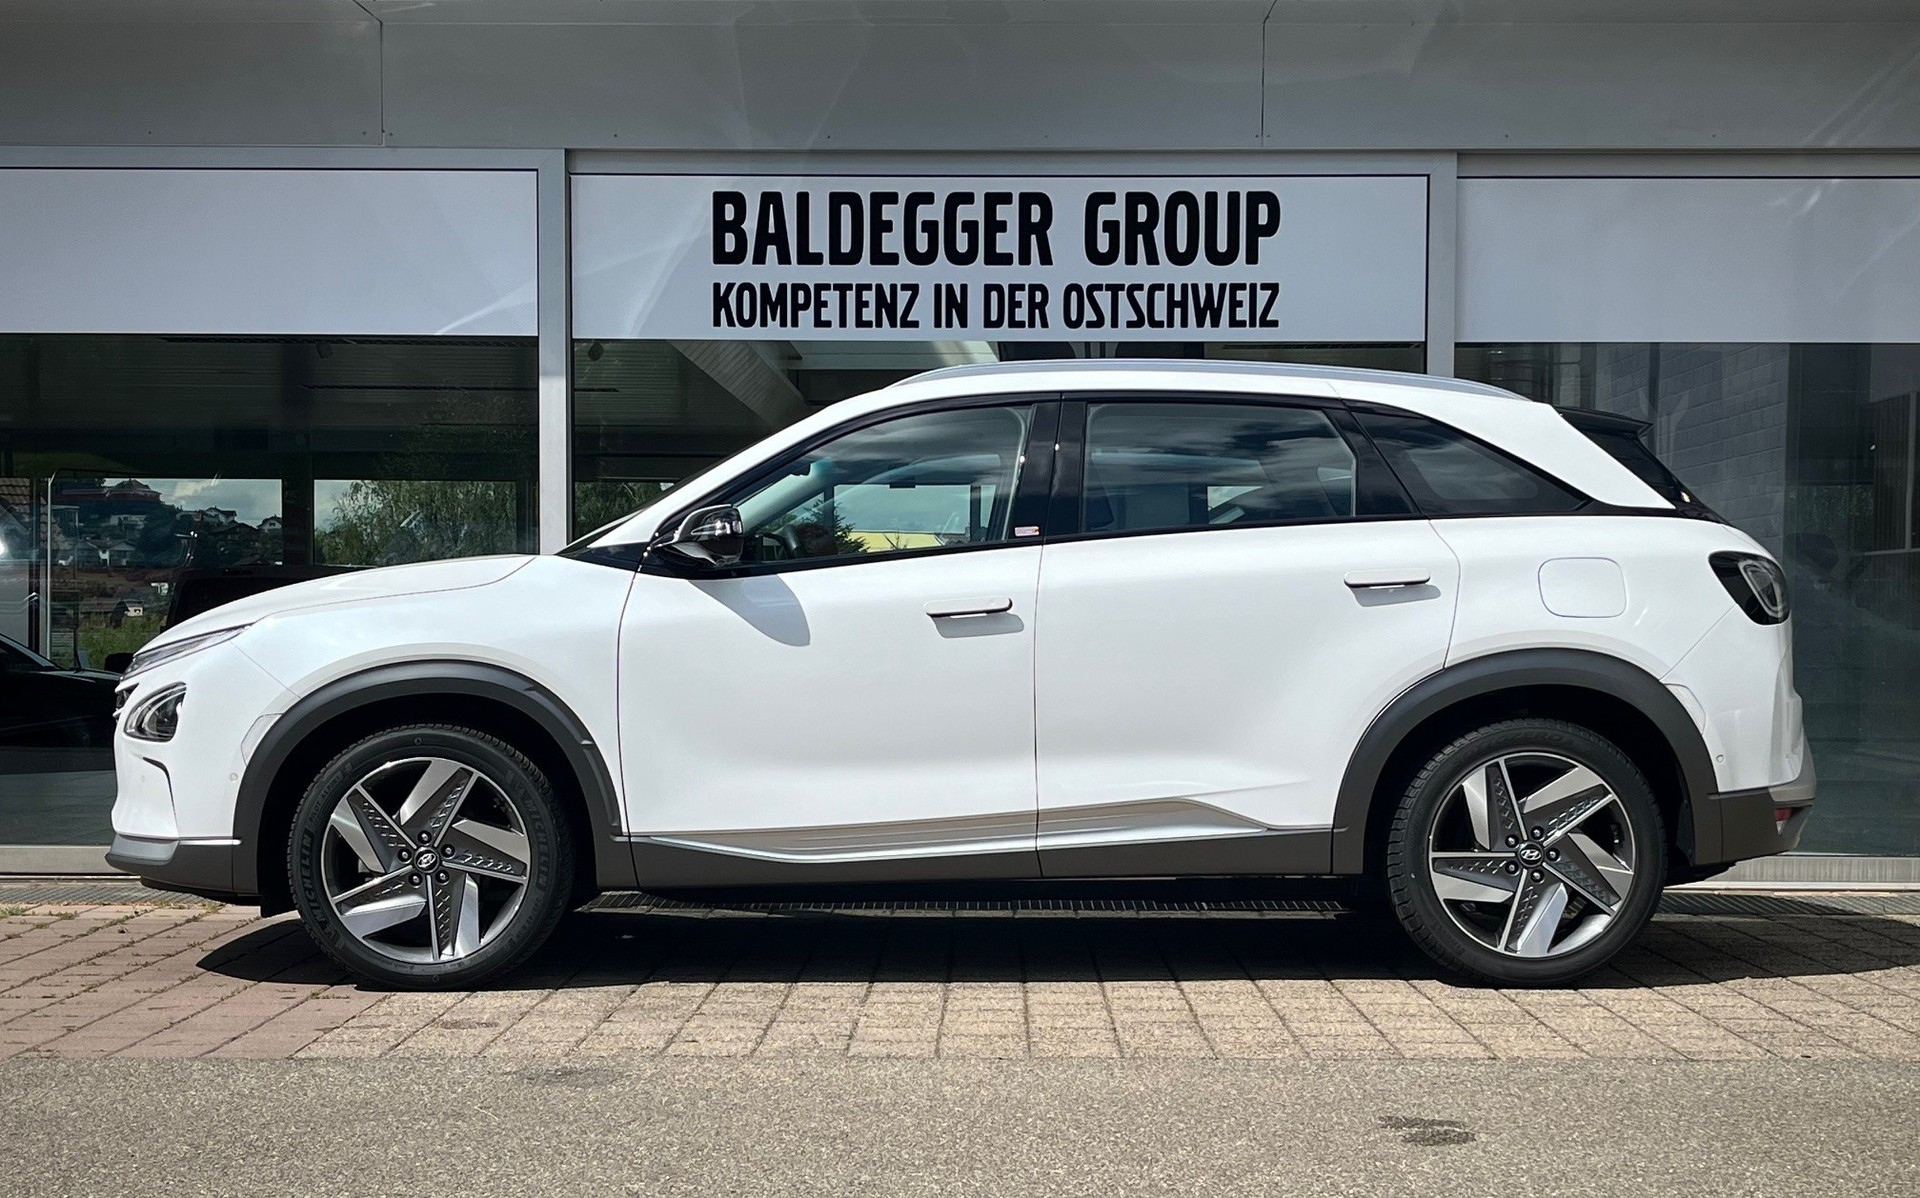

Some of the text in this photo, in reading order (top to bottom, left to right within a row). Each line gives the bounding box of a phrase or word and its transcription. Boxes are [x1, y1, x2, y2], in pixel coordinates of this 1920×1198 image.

[712, 190, 1281, 266] BALDEGGER GROUP
[712, 282, 1279, 329] KOMPETENZ IN DER OSTSCHWEIZ
[300, 833, 325, 923] MICHELIN
[525, 802, 549, 885] MICHELIN
